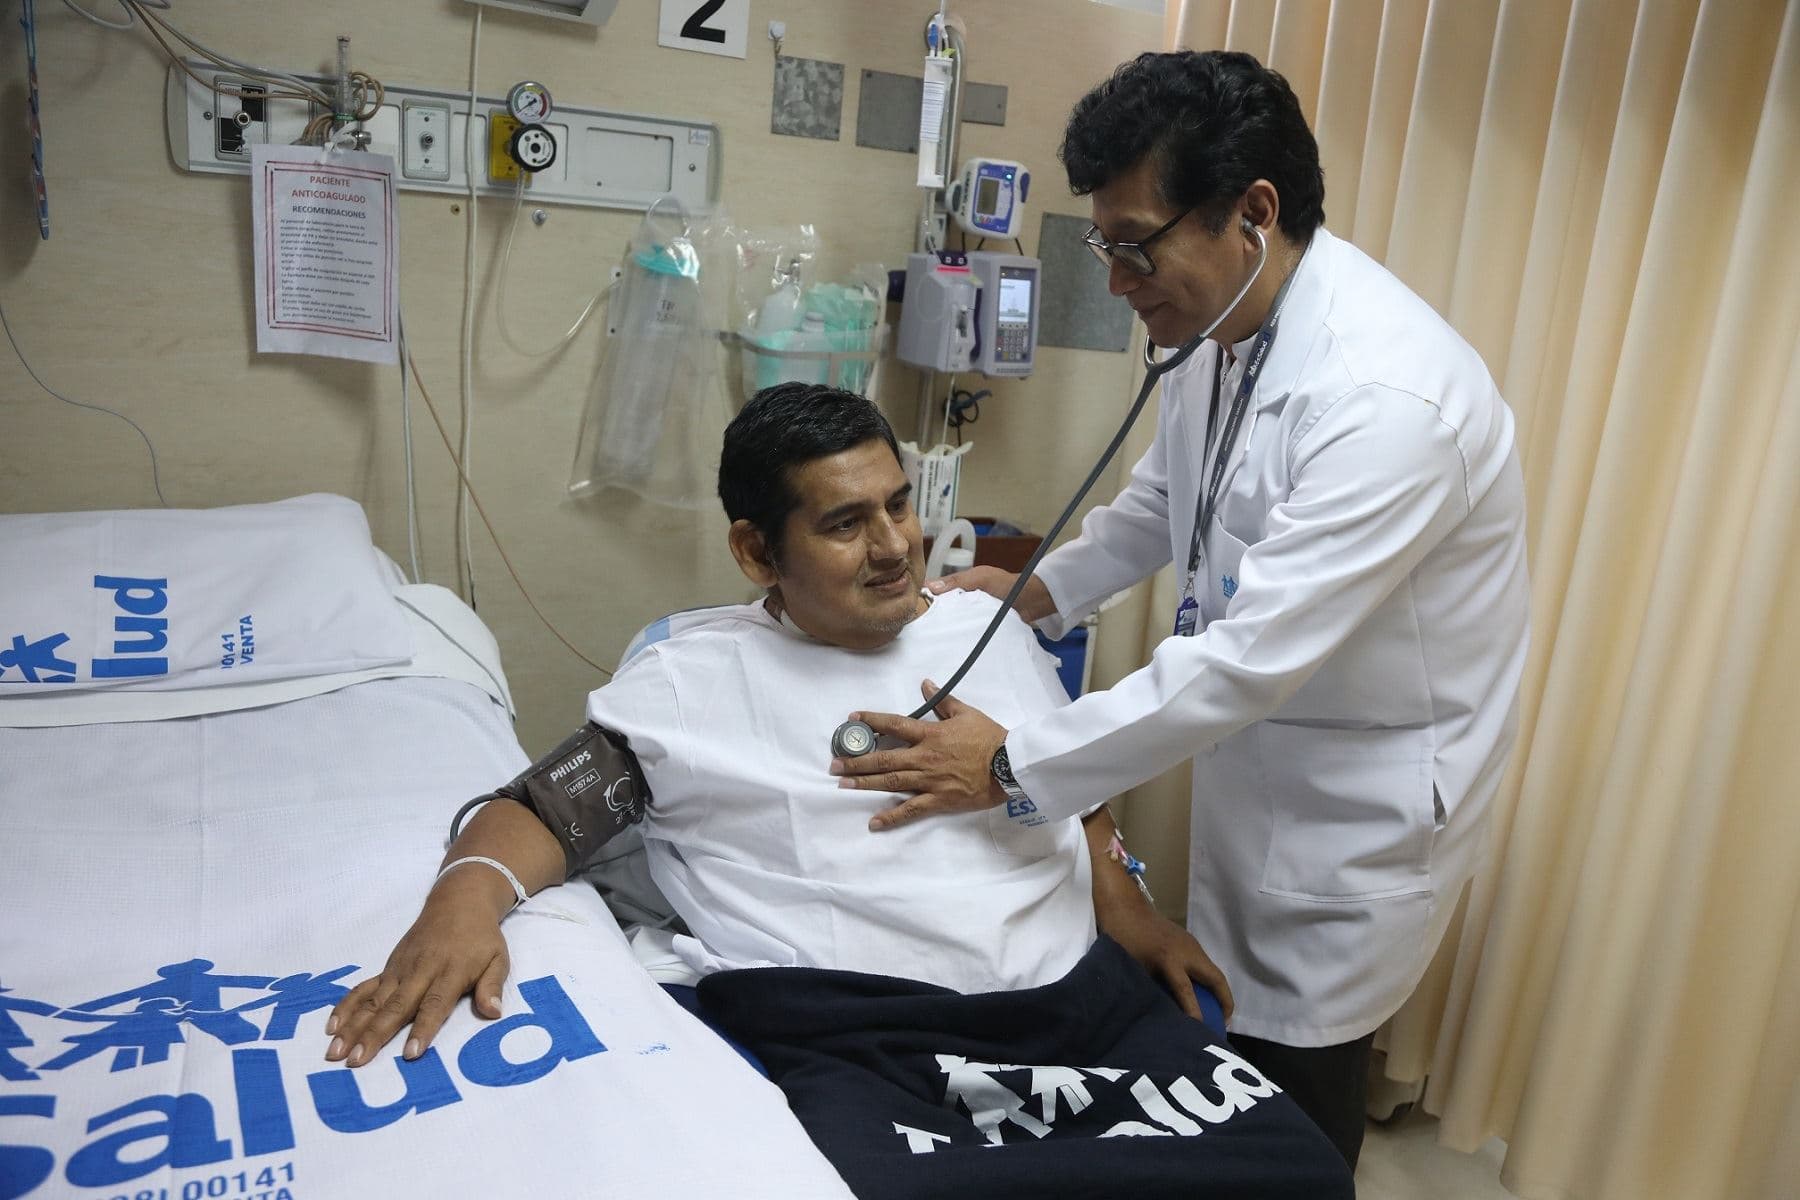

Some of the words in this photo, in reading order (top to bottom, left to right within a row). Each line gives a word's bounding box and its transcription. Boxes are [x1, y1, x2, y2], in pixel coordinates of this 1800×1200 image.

[679, 0, 725, 43] 2
[292, 189, 366, 204] ANTICOAGULADO
[310, 175, 351, 187] PACIENTE
[292, 205, 366, 219] RECOMENDACIONES
[91, 575, 168, 678] lud
[240, 614, 254, 665] VENTA
[550, 750, 591, 782] PHILIPS
[182, 1162, 295, 1200] 00141
